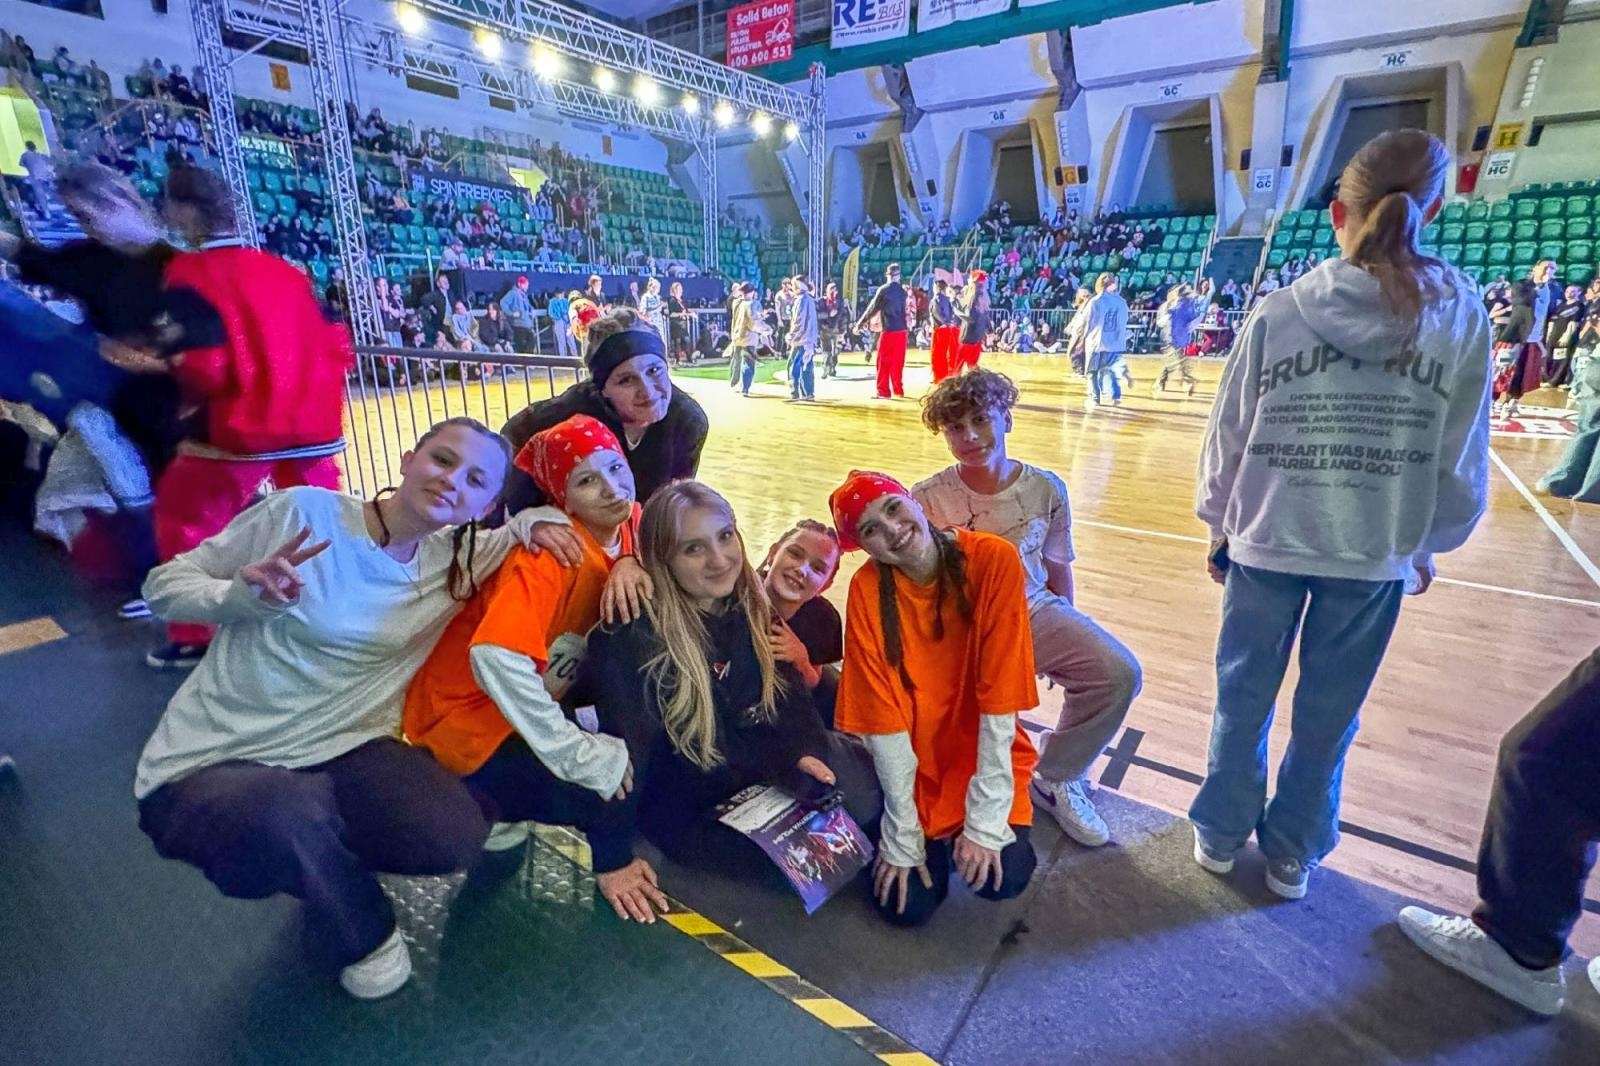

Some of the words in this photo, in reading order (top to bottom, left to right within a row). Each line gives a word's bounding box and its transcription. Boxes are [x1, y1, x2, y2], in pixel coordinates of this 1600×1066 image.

[736, 8, 760, 26] Solid
[833, 0, 886, 27] RE
[751, 50, 769, 64] 600
[772, 44, 792, 59] 551
[1387, 53, 1406, 66] HC
[1164, 86, 1178, 96] GC
[1498, 131, 1519, 146] H
[1487, 166, 1508, 175] HC
[1256, 180, 1271, 189] GC
[1324, 392, 1343, 401] YOU
[1264, 415, 1277, 424] TO
[1248, 443, 1275, 456] HER
[1276, 443, 1328, 457] HEART
[1328, 444, 1365, 458] WAS
[1407, 450, 1435, 464] OF
[1268, 457, 1328, 470] MARBLE
[1330, 458, 1363, 471] AND
